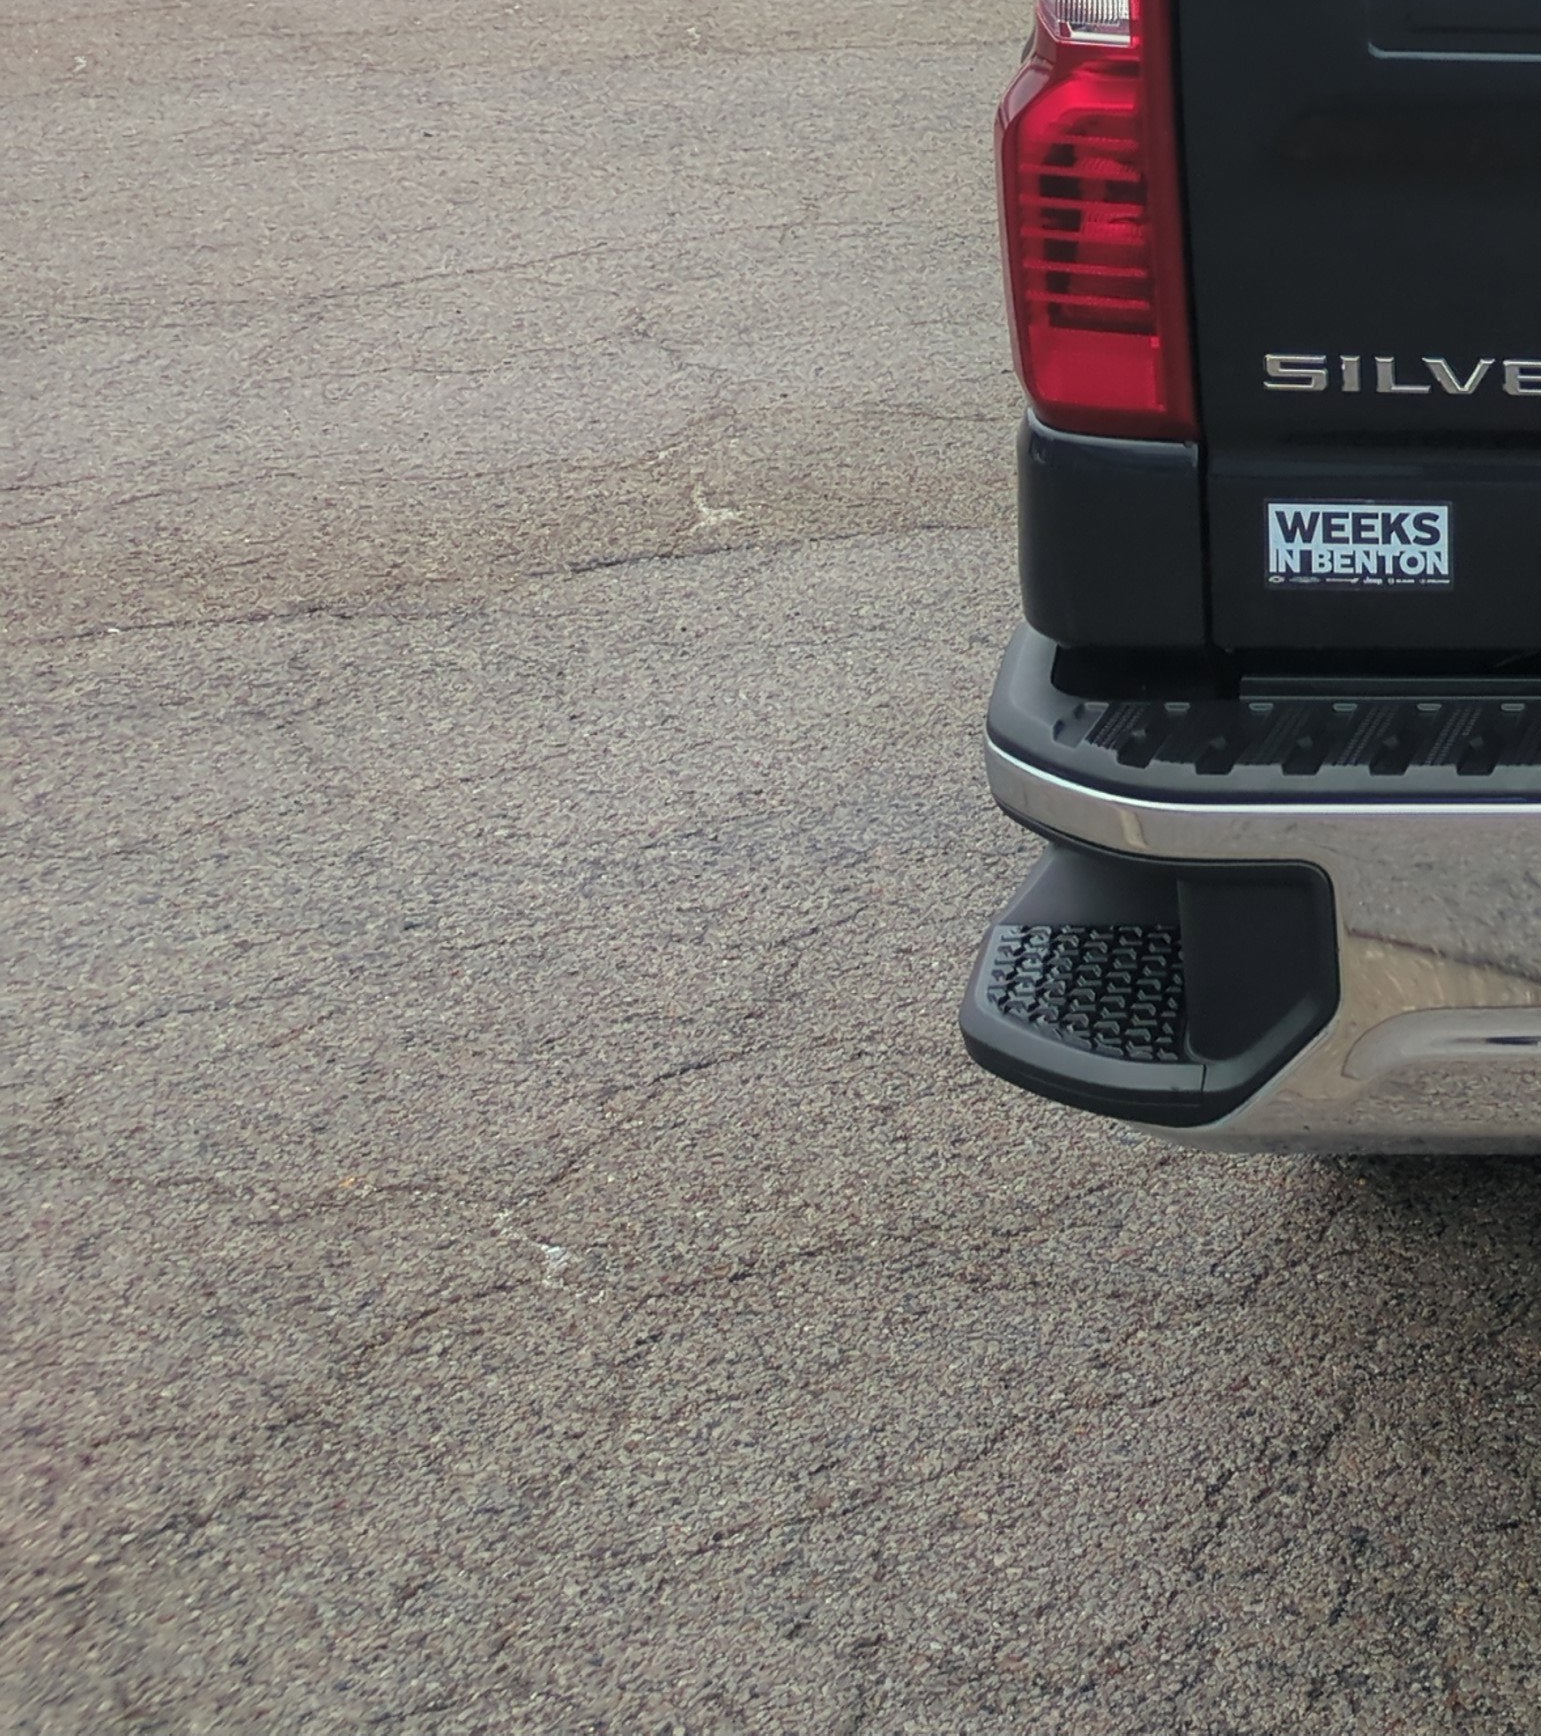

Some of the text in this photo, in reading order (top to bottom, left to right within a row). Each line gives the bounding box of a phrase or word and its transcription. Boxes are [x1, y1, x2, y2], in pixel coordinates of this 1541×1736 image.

[1275, 510, 1441, 546] WEEKS
[1269, 548, 1449, 576] IN BENTON
